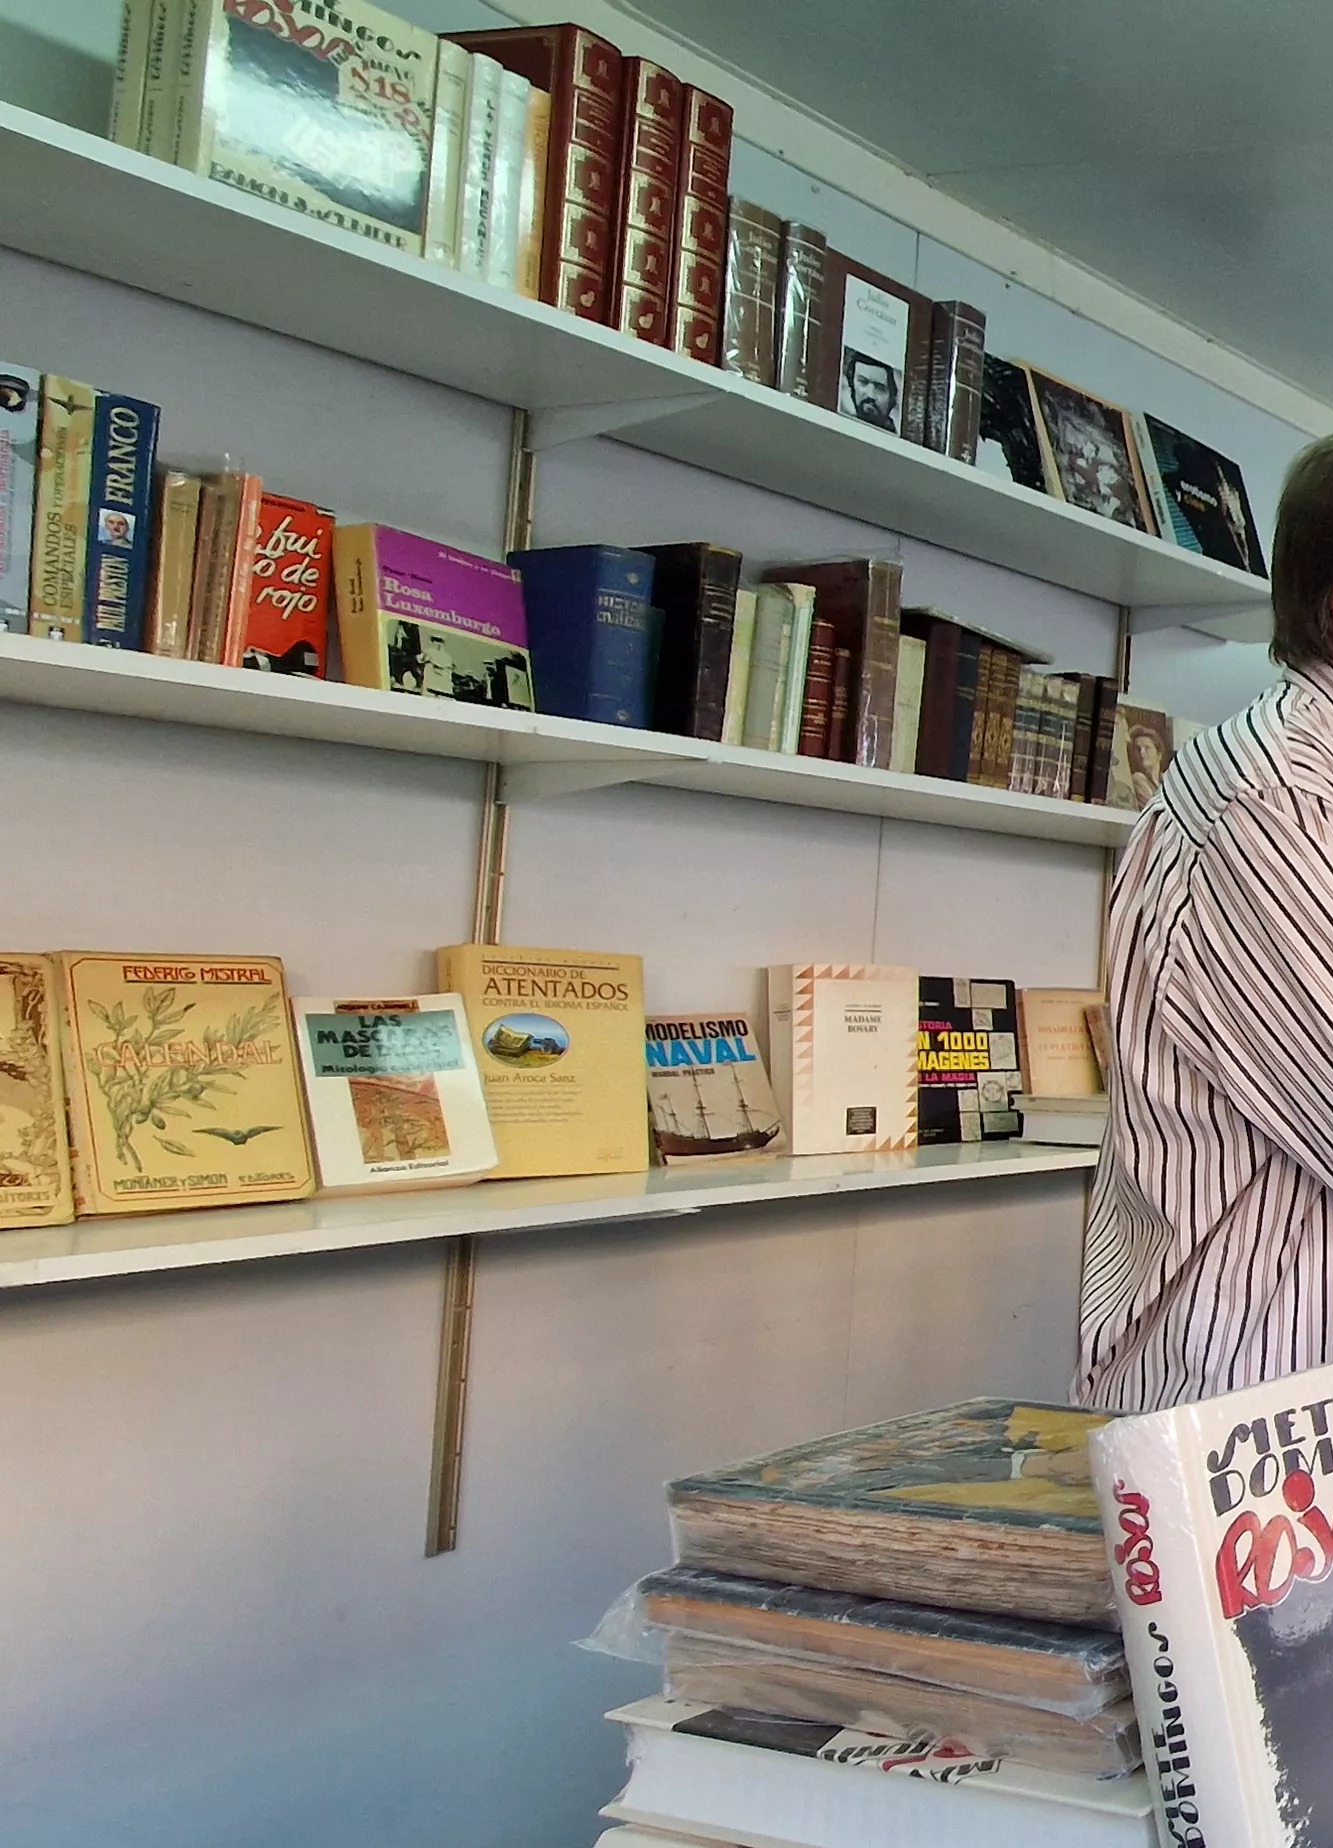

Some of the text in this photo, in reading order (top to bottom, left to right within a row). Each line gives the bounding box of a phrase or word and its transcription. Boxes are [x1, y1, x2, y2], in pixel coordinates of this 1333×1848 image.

[105, 405, 141, 507] FRANCO
[42, 511, 64, 608] COMANDOS
[281, 556, 320, 587] de
[382, 575, 434, 603] Rosa
[256, 585, 317, 621] rojo
[96, 601, 126, 633] PAUL
[385, 592, 502, 637] Luxemburgo
[200, 967, 272, 983] MISTRAL
[482, 965, 587, 980] DICCIONARIO DE
[484, 977, 630, 1002] ATENTADOS
[482, 997, 527, 1009] CONTRA
[530, 999, 542, 1009] EL
[359, 1015, 404, 1029] LAS
[844, 1014, 883, 1025] MADAME
[846, 1024, 880, 1034] BOVARY
[344, 1045, 373, 1059] DE
[644, 1036, 758, 1068] NAVAL
[937, 1031, 989, 1051] 1000
[97, 1040, 283, 1068] CALENDAL
[484, 1073, 577, 1086] Juan Aroca Sanz
[926, 1072, 976, 1083] LA MAGIA
